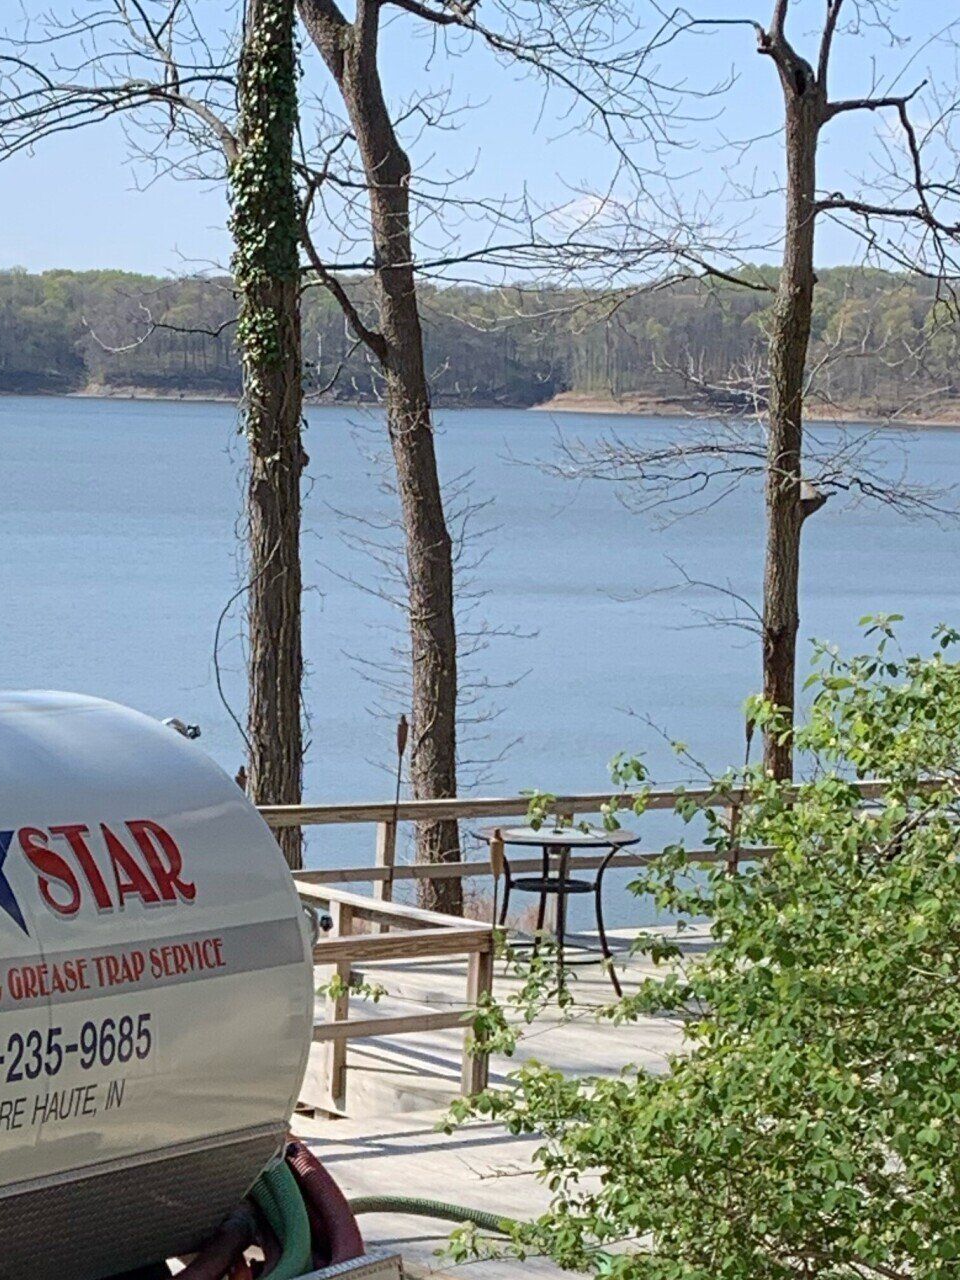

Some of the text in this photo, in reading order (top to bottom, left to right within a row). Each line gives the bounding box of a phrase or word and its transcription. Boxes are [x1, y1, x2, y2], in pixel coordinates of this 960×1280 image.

[17, 819, 197, 919] STAR
[8, 959, 91, 1000] GREASE
[92, 951, 145, 989] TRAP
[149, 938, 227, 979] SERVICE
[32, 1083, 99, 1125] HAUTE,
[105, 1079, 126, 1109] IN
